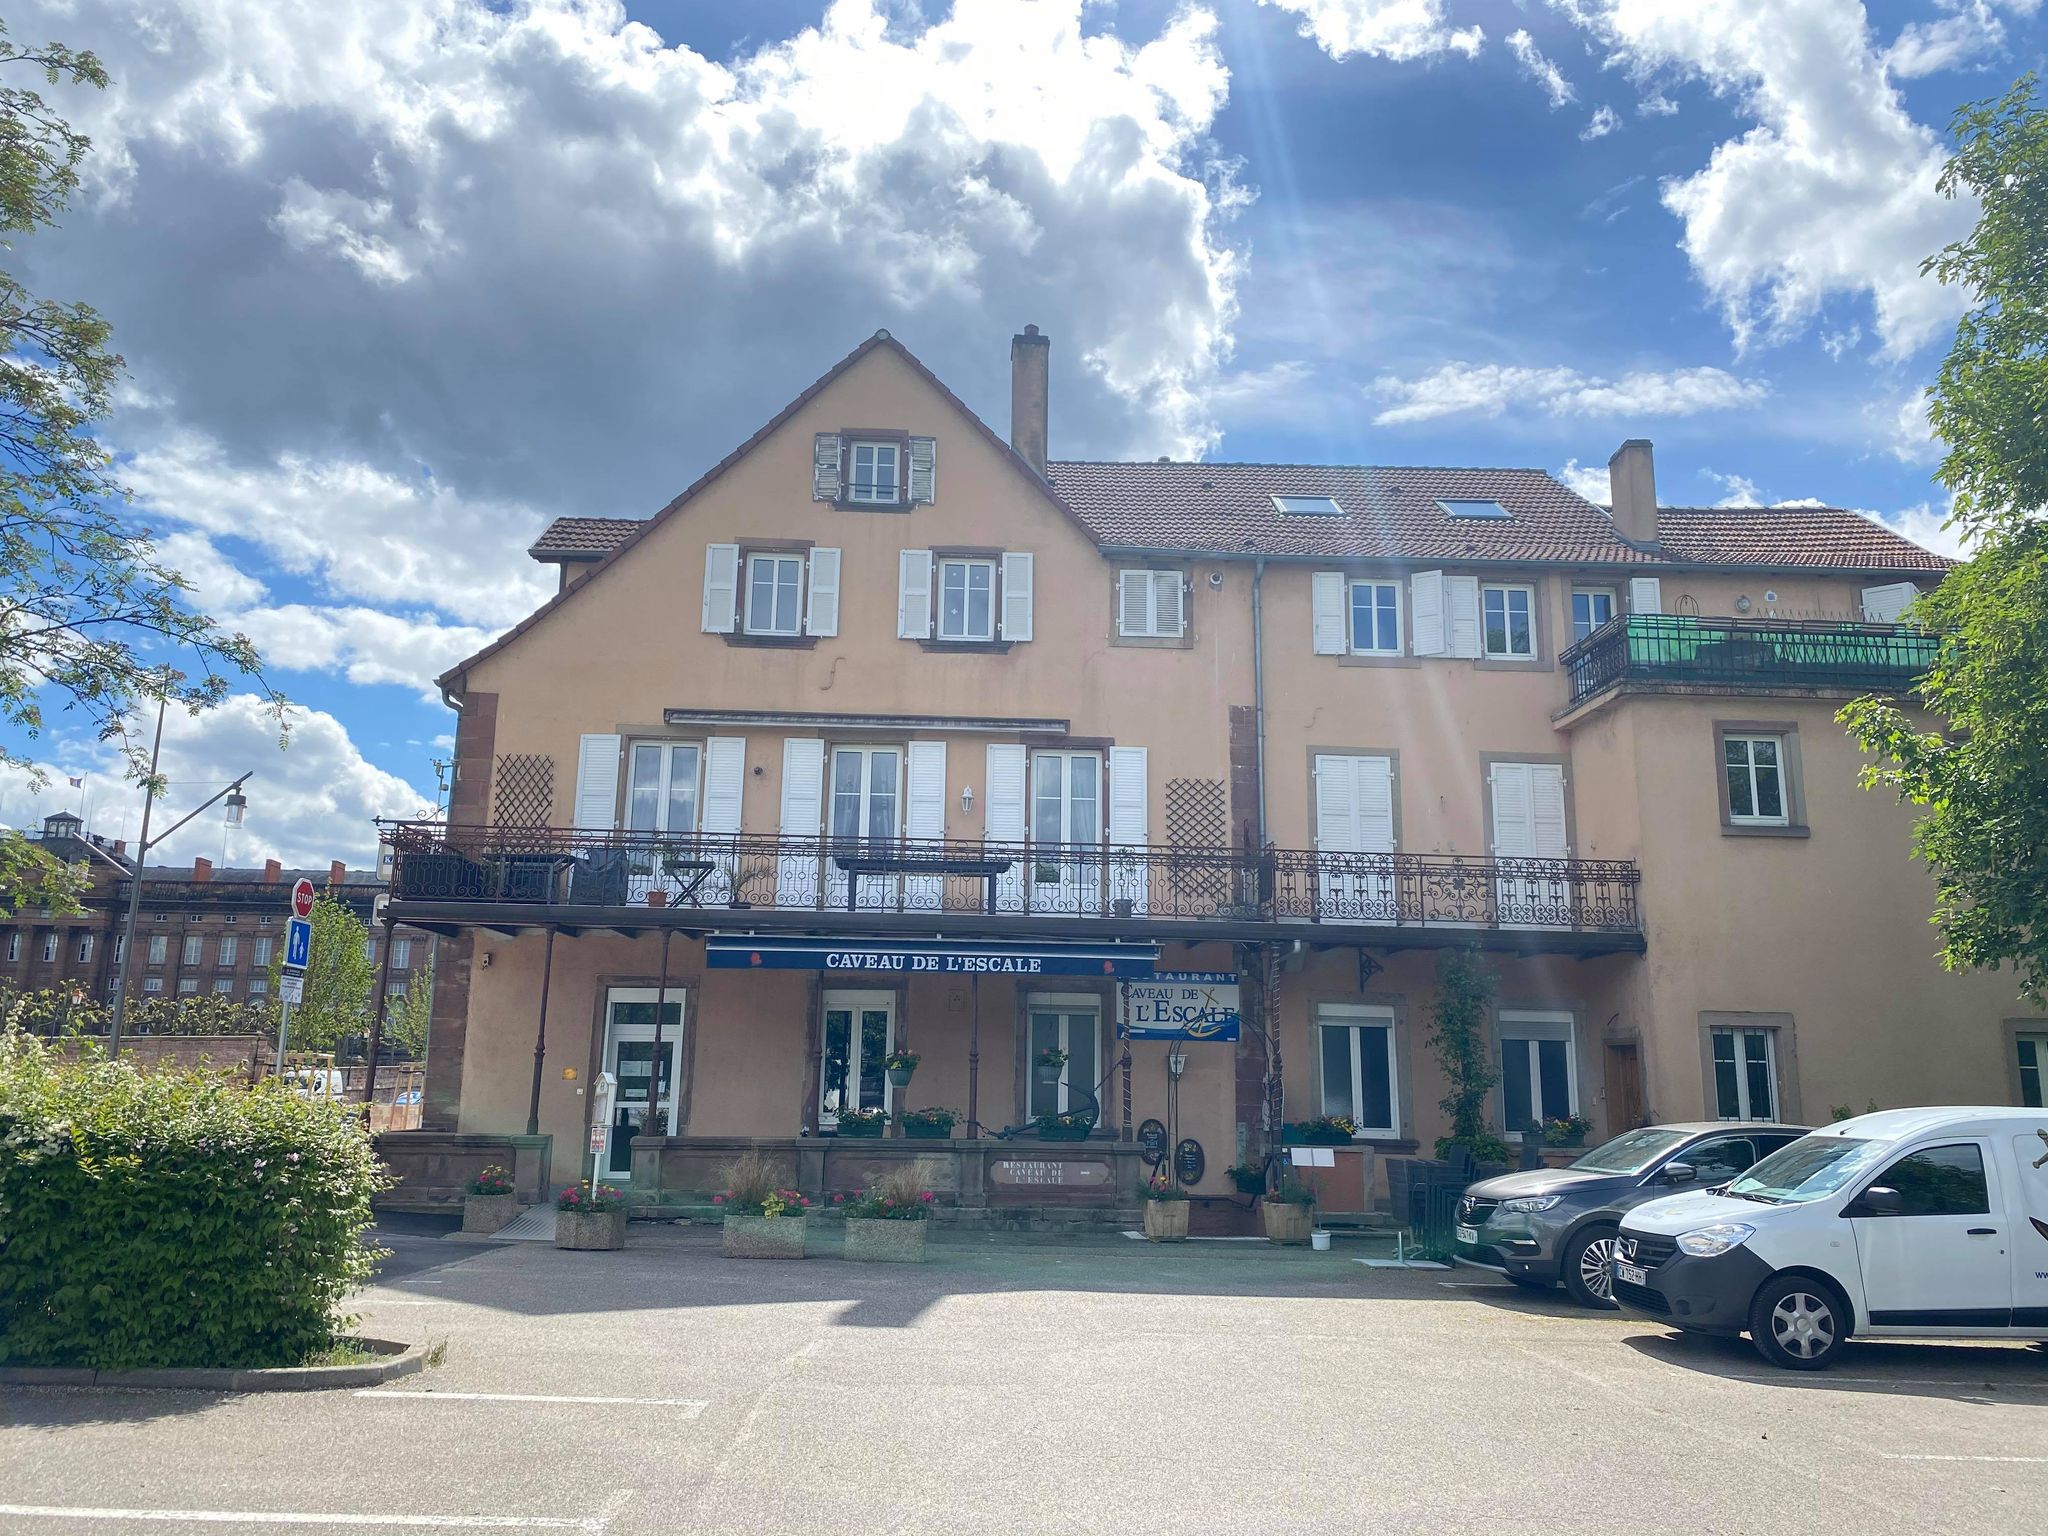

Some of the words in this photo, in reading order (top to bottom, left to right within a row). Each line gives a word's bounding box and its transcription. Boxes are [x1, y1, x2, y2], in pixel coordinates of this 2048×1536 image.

[297, 892, 313, 904] STOP
[826, 953, 905, 969] CAVEAU
[912, 956, 939, 970] DE
[946, 956, 1041, 973] L'ESCALE
[1118, 972, 1237, 982] TAURANT
[1182, 989, 1199, 999] DE
[1003, 1161, 1063, 1169] RESTAURANT
[1051, 1169, 1064, 1177] DE
